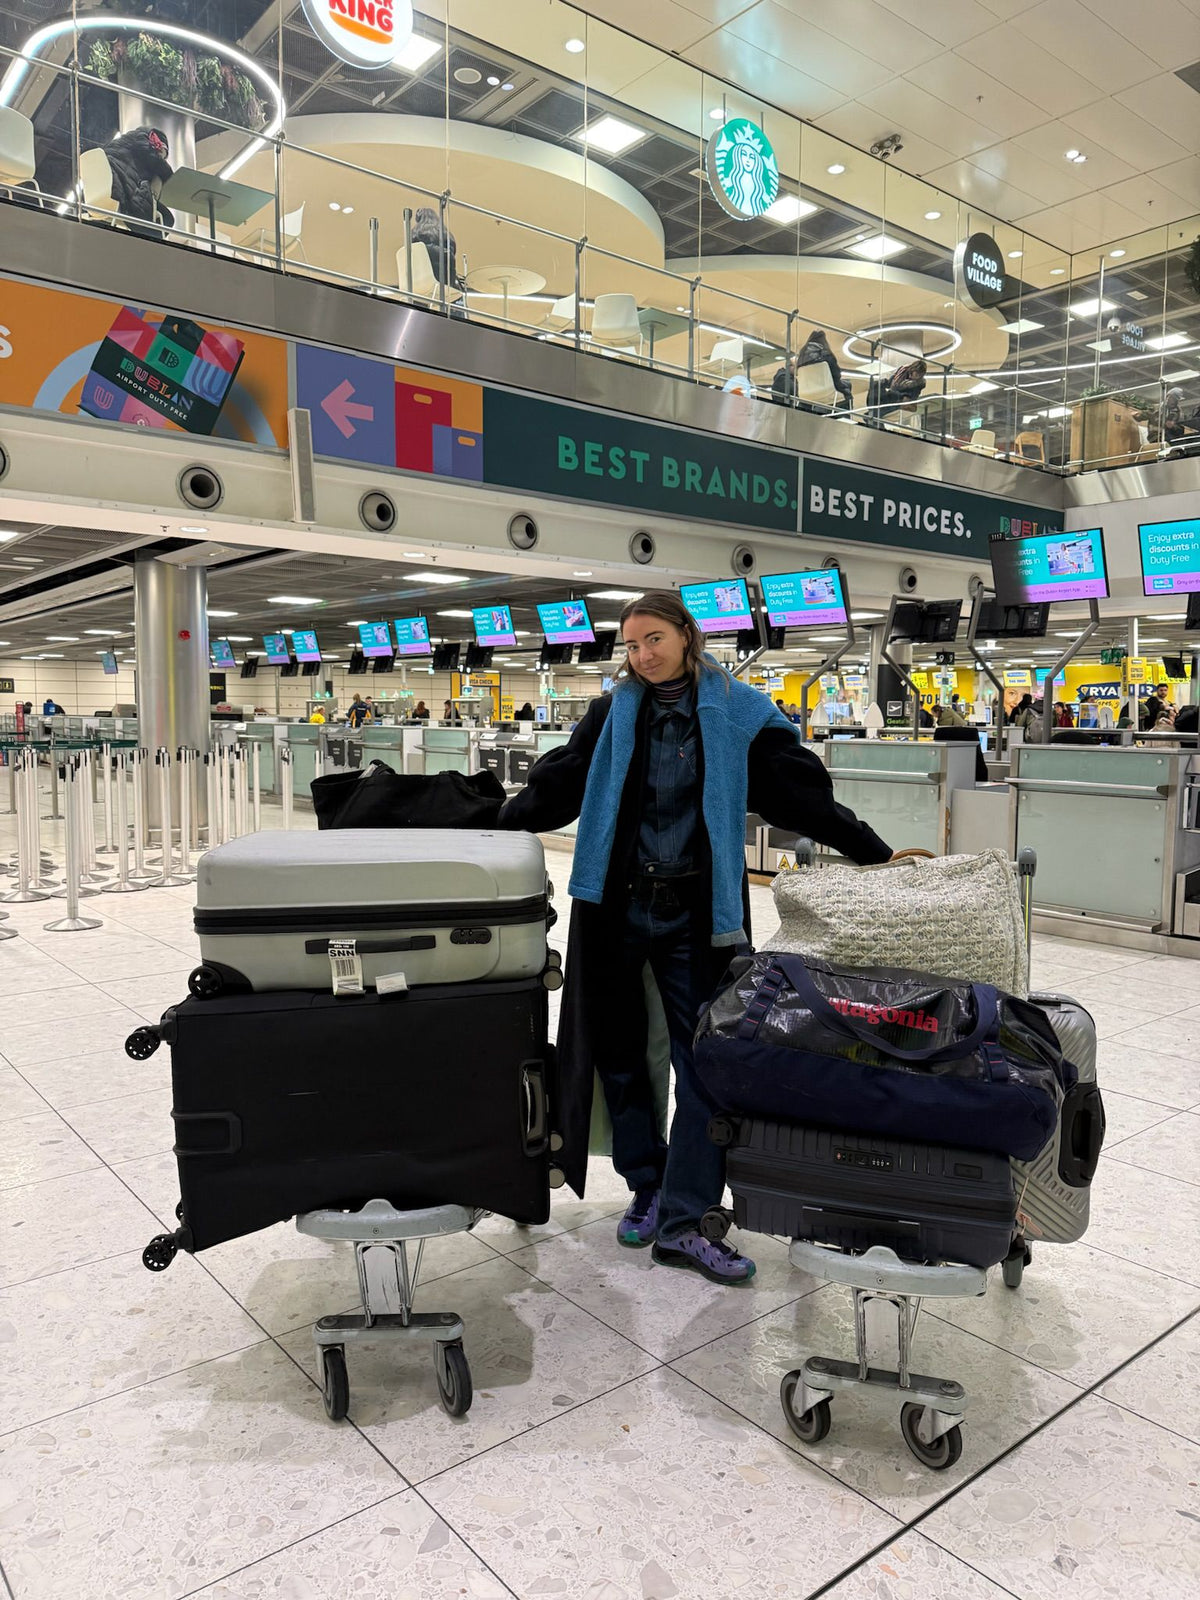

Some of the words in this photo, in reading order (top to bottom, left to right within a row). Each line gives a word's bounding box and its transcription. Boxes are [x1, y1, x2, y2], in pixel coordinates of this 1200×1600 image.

[972, 252, 997, 273] FOOD
[967, 266, 1002, 292] VILLAGE
[116, 372, 147, 394] AIRPORT
[149, 393, 169, 409] DUTY
[170, 407, 188, 421] FREE
[558, 435, 649, 483] BEST
[662, 456, 797, 510] BRANDS.
[810, 484, 874, 522] BEST
[883, 498, 972, 539] PRICES.
[1148, 534, 1170, 543] Enjoy
[1172, 532, 1195, 540] extra
[1149, 544, 1190, 553] discounts
[1150, 557, 1170, 565] Duty
[329, 949, 355, 957] SNN
[828, 997, 938, 1033] atagonia
